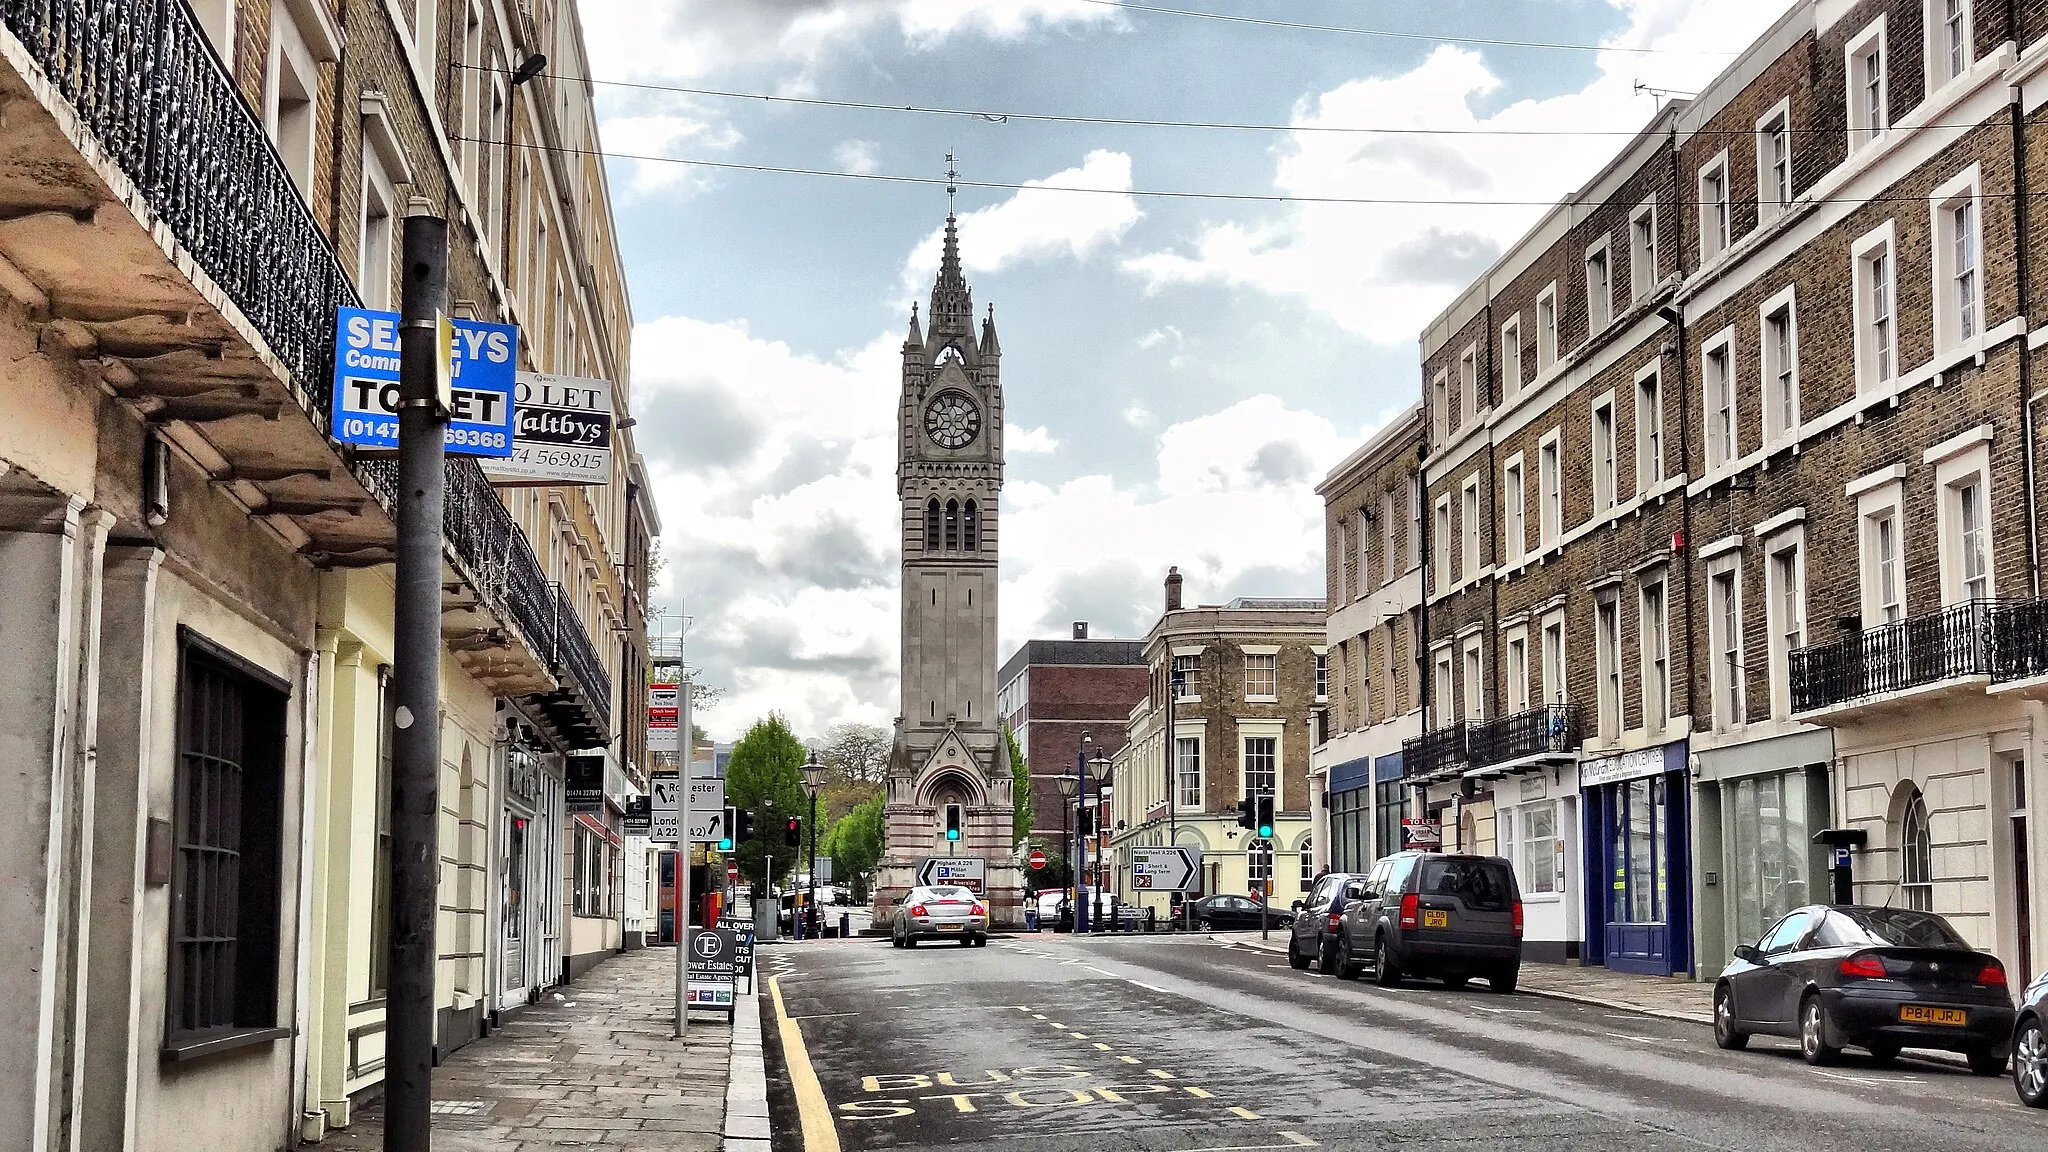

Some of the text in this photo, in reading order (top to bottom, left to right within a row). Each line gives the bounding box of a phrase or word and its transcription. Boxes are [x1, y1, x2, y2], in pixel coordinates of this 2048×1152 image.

[515, 383, 602, 409] O LET
[451, 391, 500, 422] ET
[444, 428, 506, 449] 69368
[536, 450, 602, 470] 569815
[669, 783, 715, 792] Rester
[654, 816, 680, 826] Lond
[1836, 848, 1849, 865] P
[939, 867, 946, 877] P
[1136, 864, 1142, 872] P
[716, 921, 755, 930] ALL OVER
[687, 960, 734, 970] ower Estates
[1906, 1007, 1962, 1022] P841 JRJ
[861, 1065, 1092, 1092] BUS
[837, 1083, 1173, 1120] STOP
